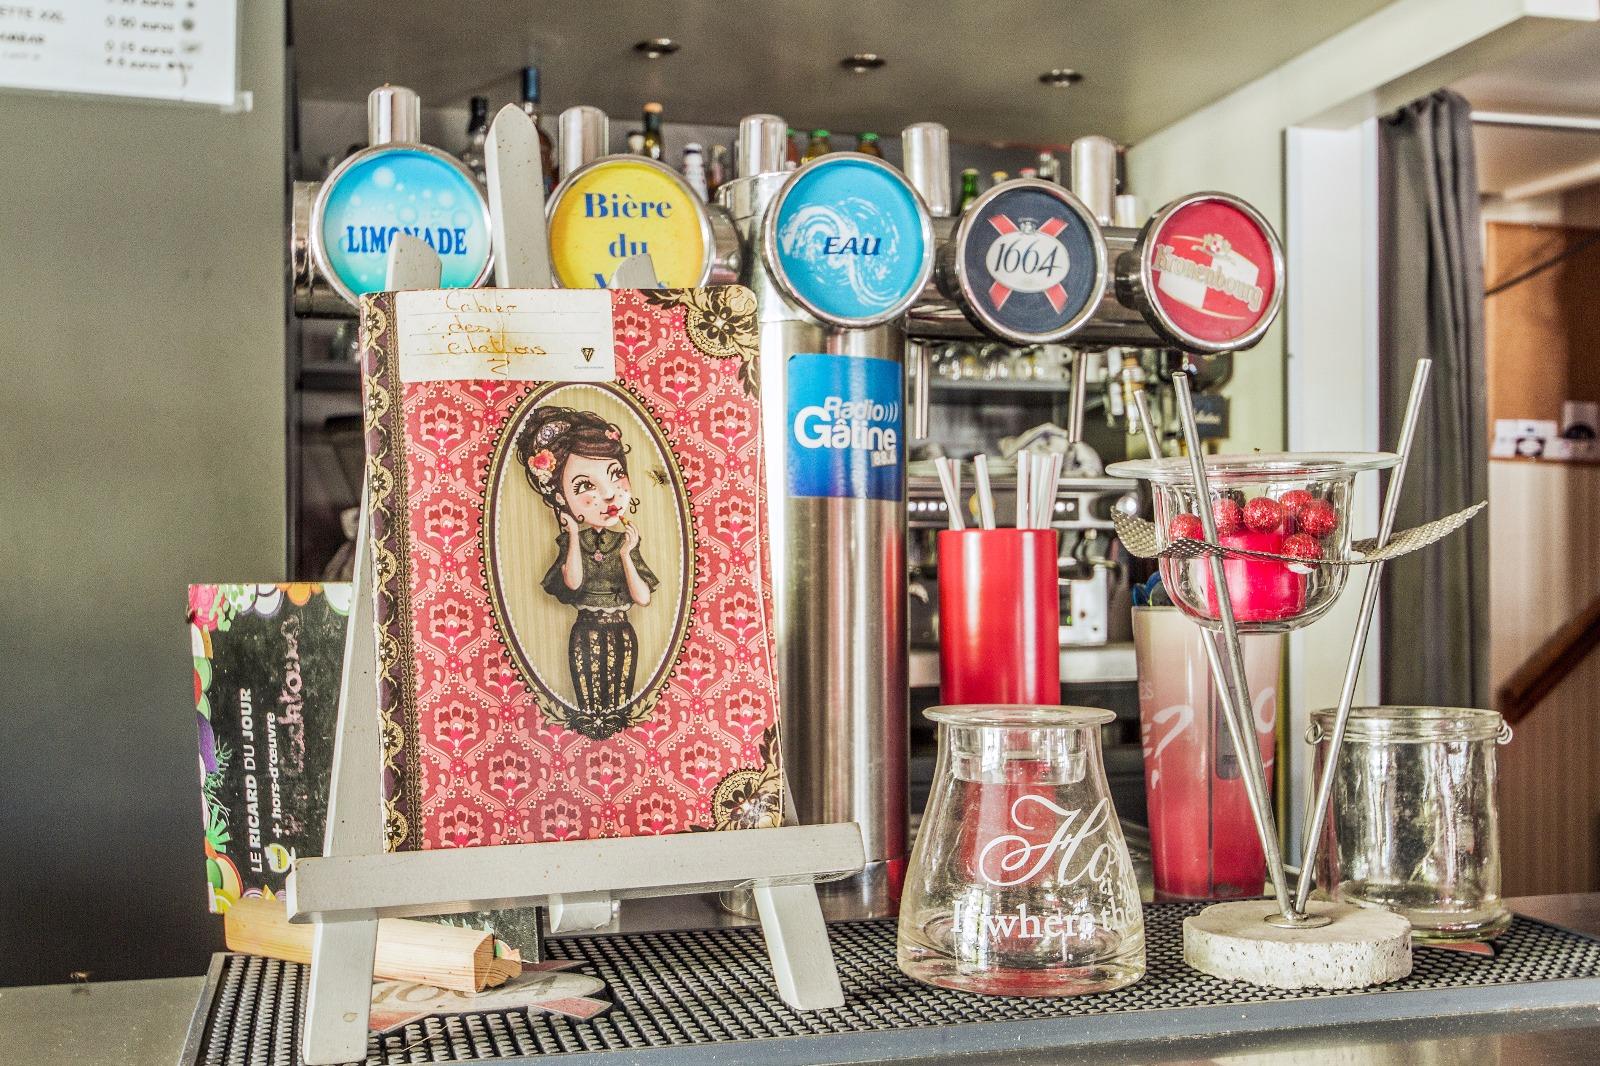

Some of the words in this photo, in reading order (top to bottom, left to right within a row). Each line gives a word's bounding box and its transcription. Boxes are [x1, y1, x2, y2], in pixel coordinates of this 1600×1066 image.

[584, 192, 672, 218] Bière
[824, 236, 881, 256] EAU
[994, 238, 1062, 277] 1664
[1151, 244, 1264, 313] Kronenbourg
[824, 396, 885, 421] Radio
[794, 405, 897, 450] Gâtine
[240, 688, 254, 742] JOUR
[243, 744, 256, 771] DU
[245, 774, 261, 849] RICARD
[250, 851, 263, 873] LE
